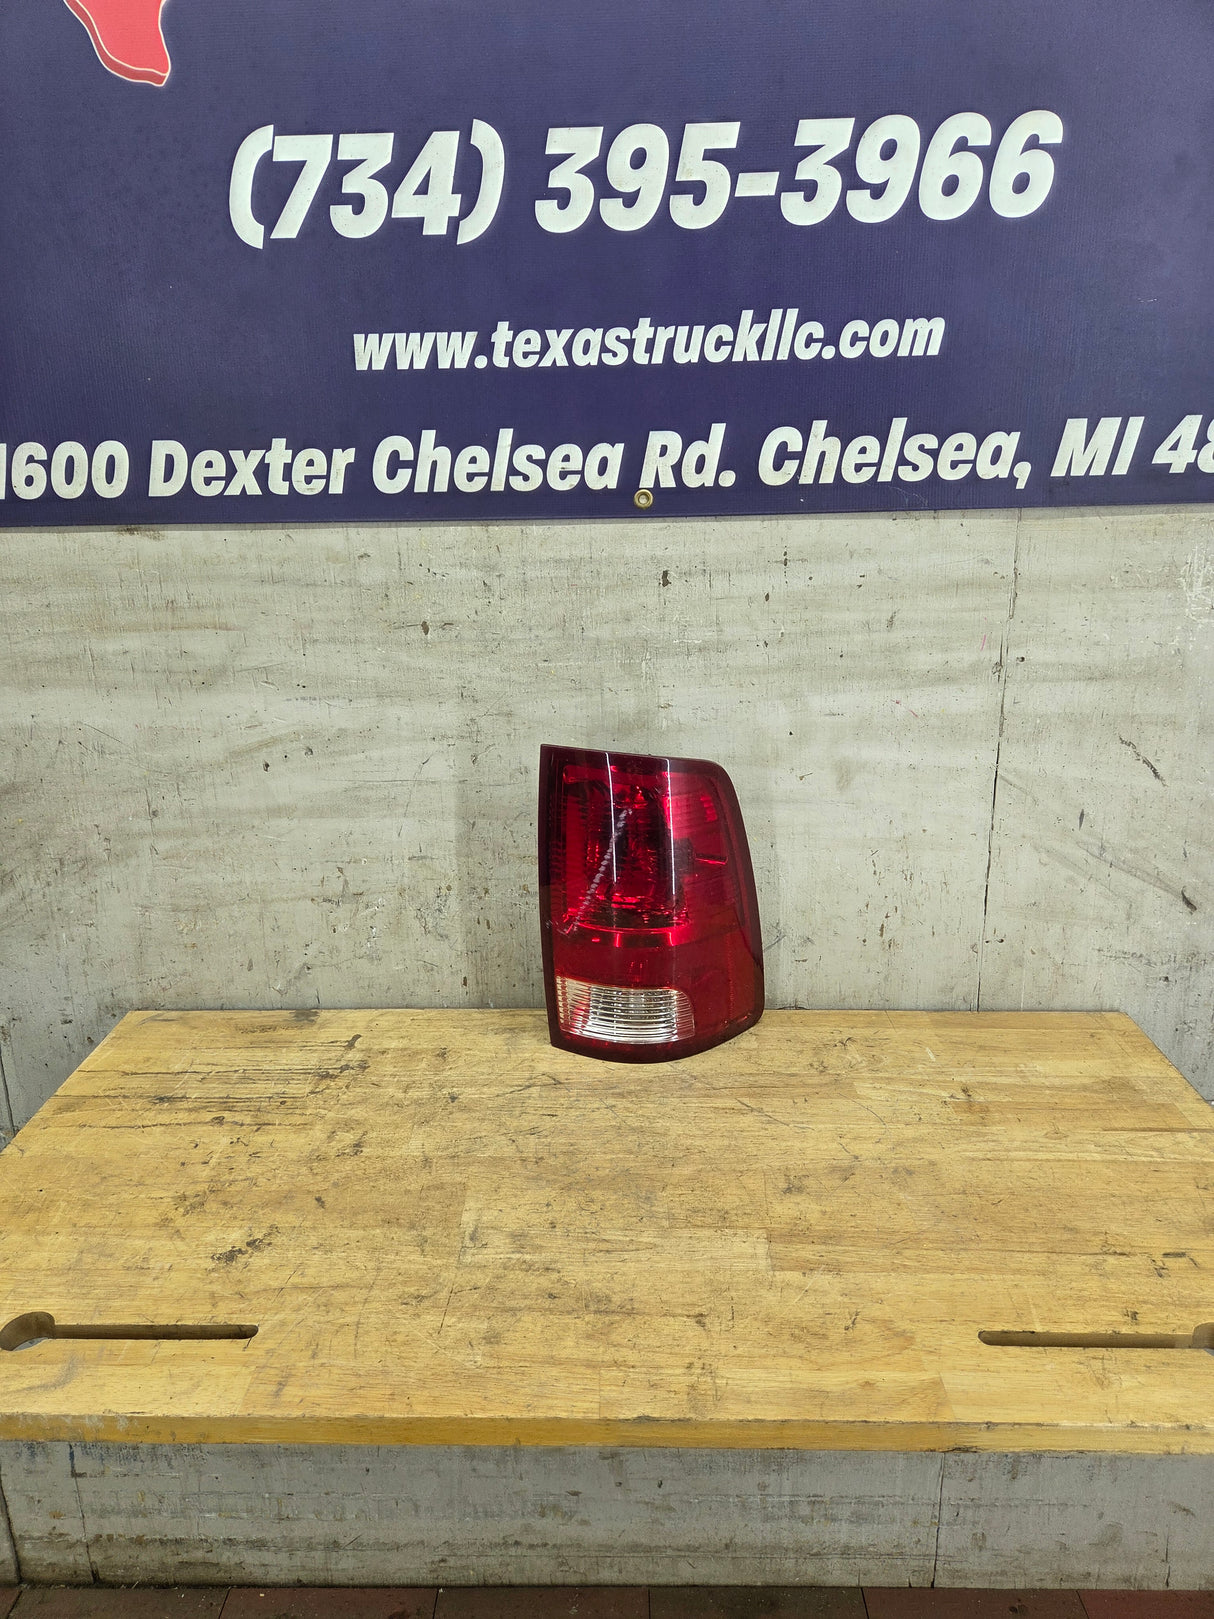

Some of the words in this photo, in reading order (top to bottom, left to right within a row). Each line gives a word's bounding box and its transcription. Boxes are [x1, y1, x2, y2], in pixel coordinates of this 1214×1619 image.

[229, 119, 505, 249] (734)
[534, 110, 1064, 233] 395-3966
[353, 308, 946, 371] www.texastruckllc.com
[148, 438, 356, 497] Dexter
[372, 429, 625, 494] Chelsea
[638, 423, 736, 489] Rd.
[758, 417, 1032, 490] Chelsea,
[1050, 416, 1145, 477] MI
